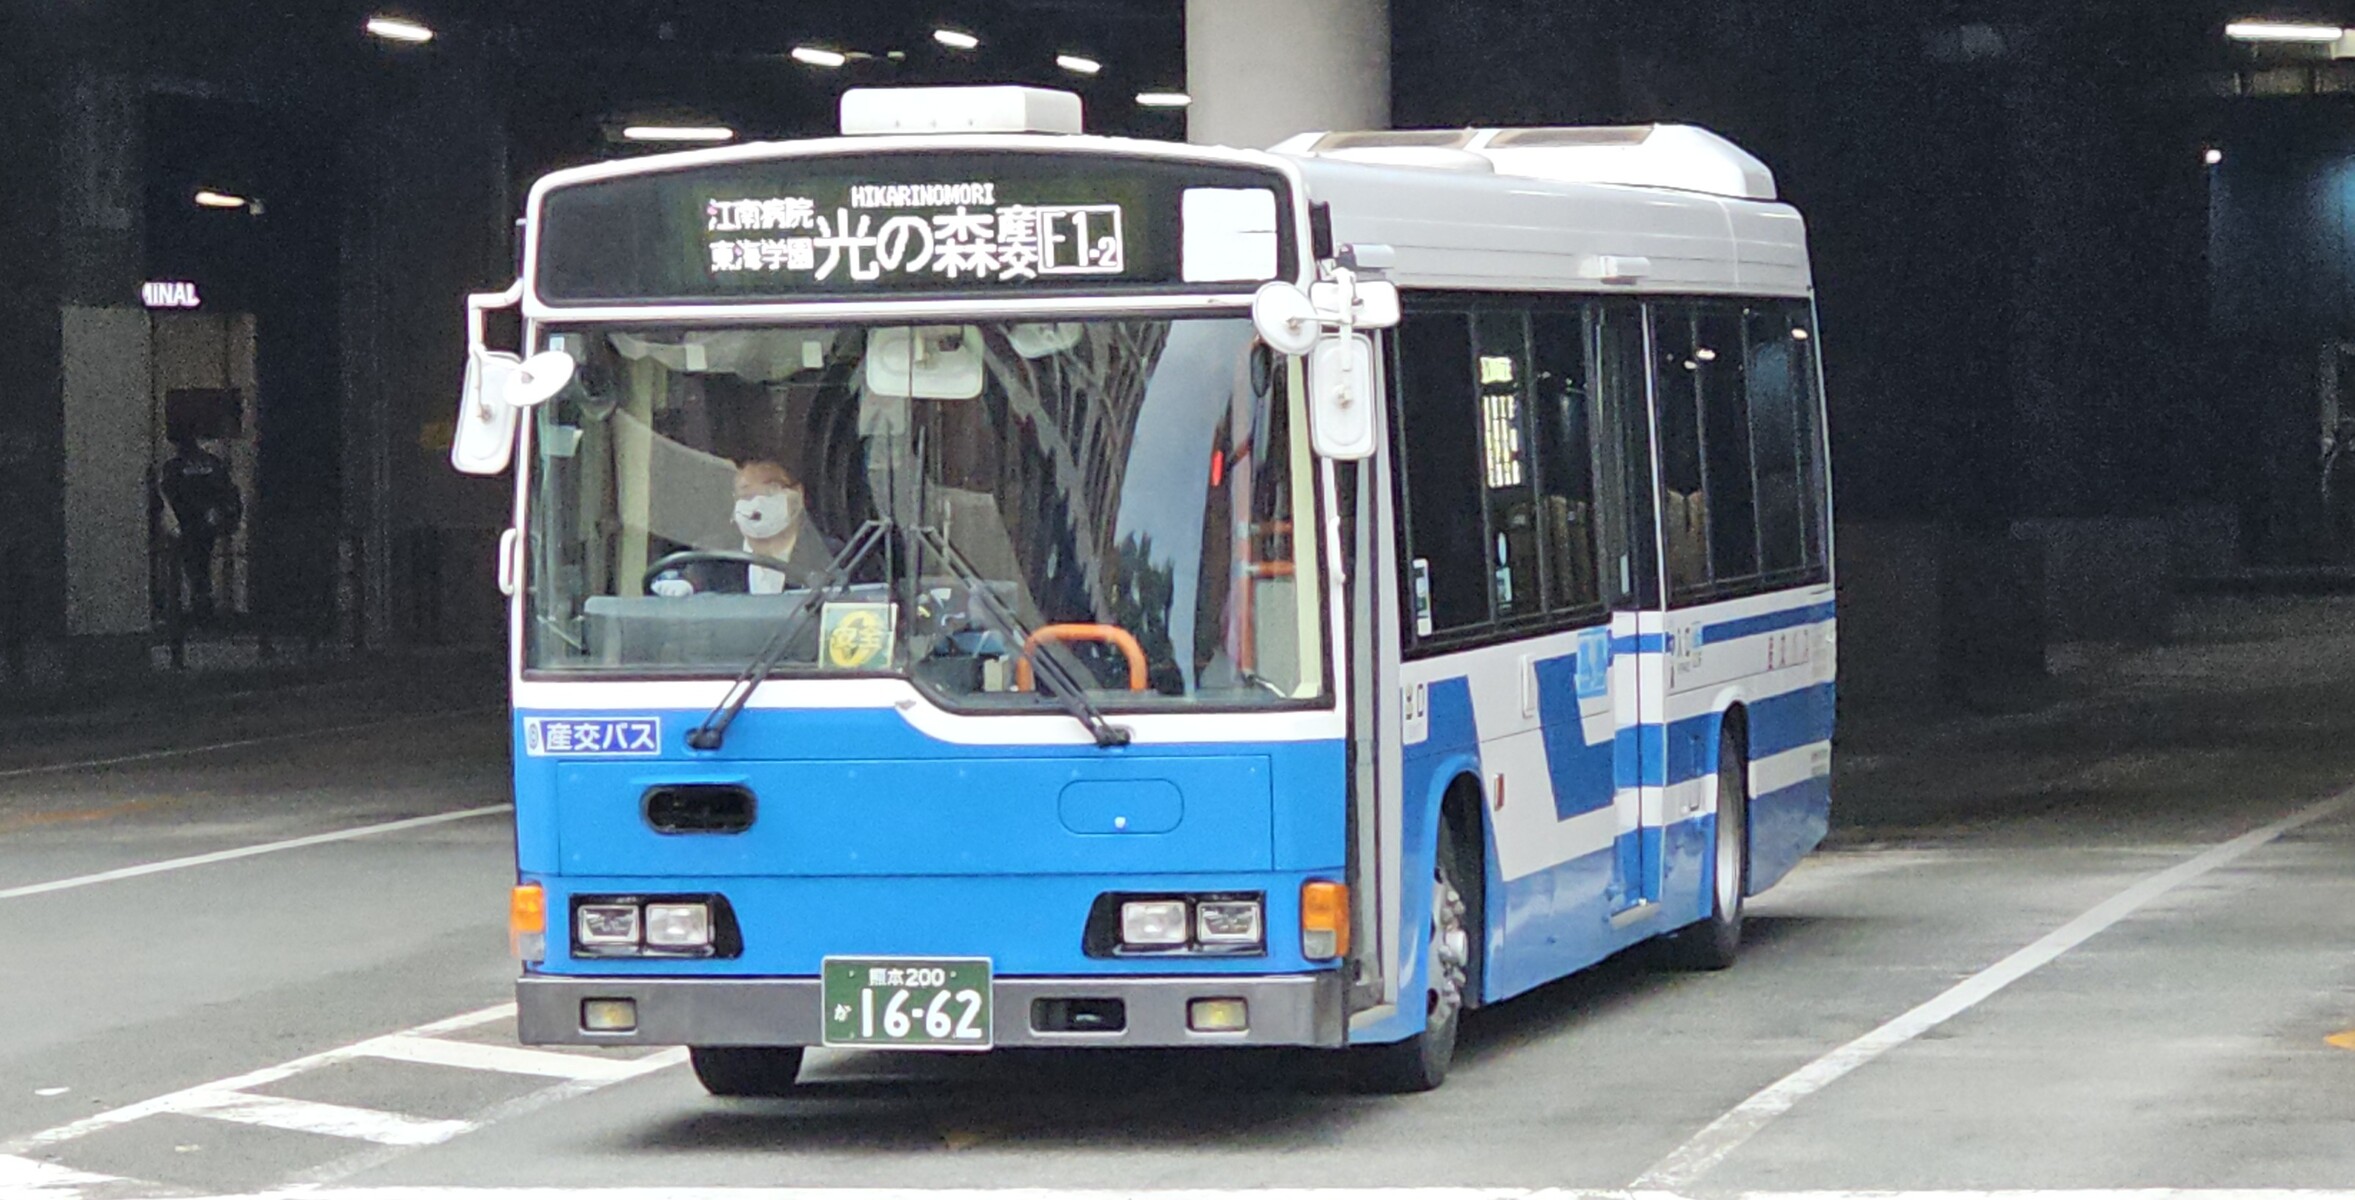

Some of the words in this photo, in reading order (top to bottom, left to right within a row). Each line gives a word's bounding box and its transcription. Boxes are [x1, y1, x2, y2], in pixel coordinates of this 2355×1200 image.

[851, 182, 996, 208] HIKARINOMORI
[707, 197, 815, 231] 江南病院
[708, 237, 815, 272] 東海学園
[813, 205, 1001, 282] 光の森
[546, 722, 656, 751] 産交バス
[861, 987, 983, 1039] 16-62
